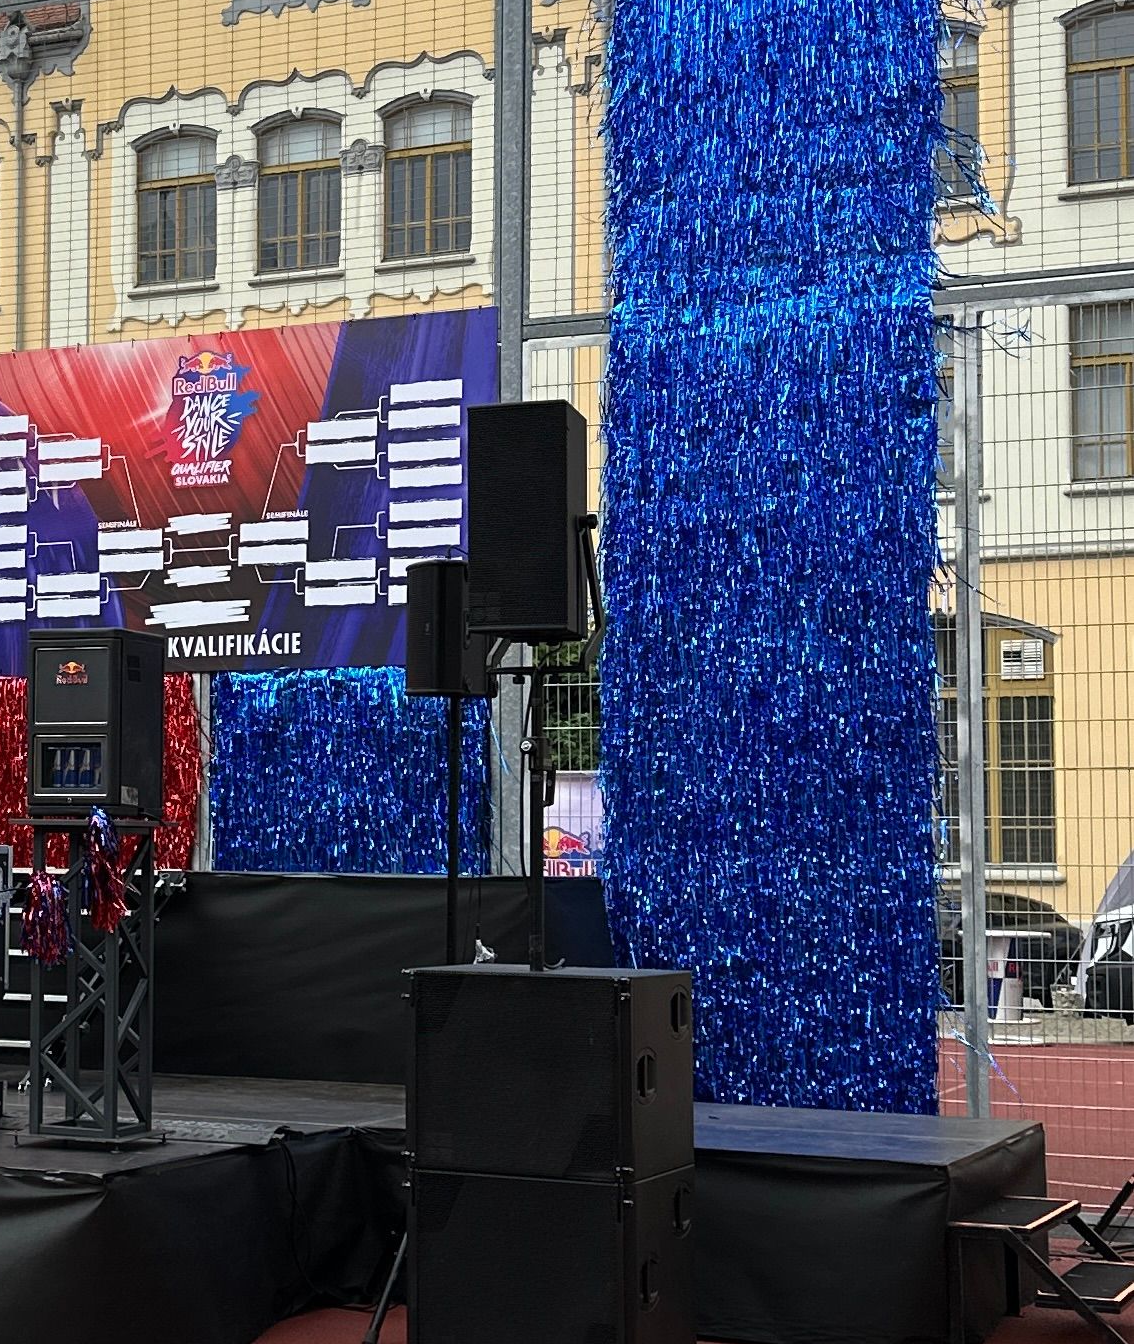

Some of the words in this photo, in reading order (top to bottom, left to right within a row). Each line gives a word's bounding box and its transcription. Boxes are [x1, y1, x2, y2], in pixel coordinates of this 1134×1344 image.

[175, 376, 205, 394] Red
[207, 373, 236, 391] Bull
[179, 393, 232, 421] DANCE
[184, 409, 235, 439] YOUR
[180, 425, 232, 461] STYLE
[171, 459, 232, 476] QUALIFIER
[175, 474, 229, 487] SLOVAKIA
[167, 628, 301, 658] KVALIFIKÁCIE
